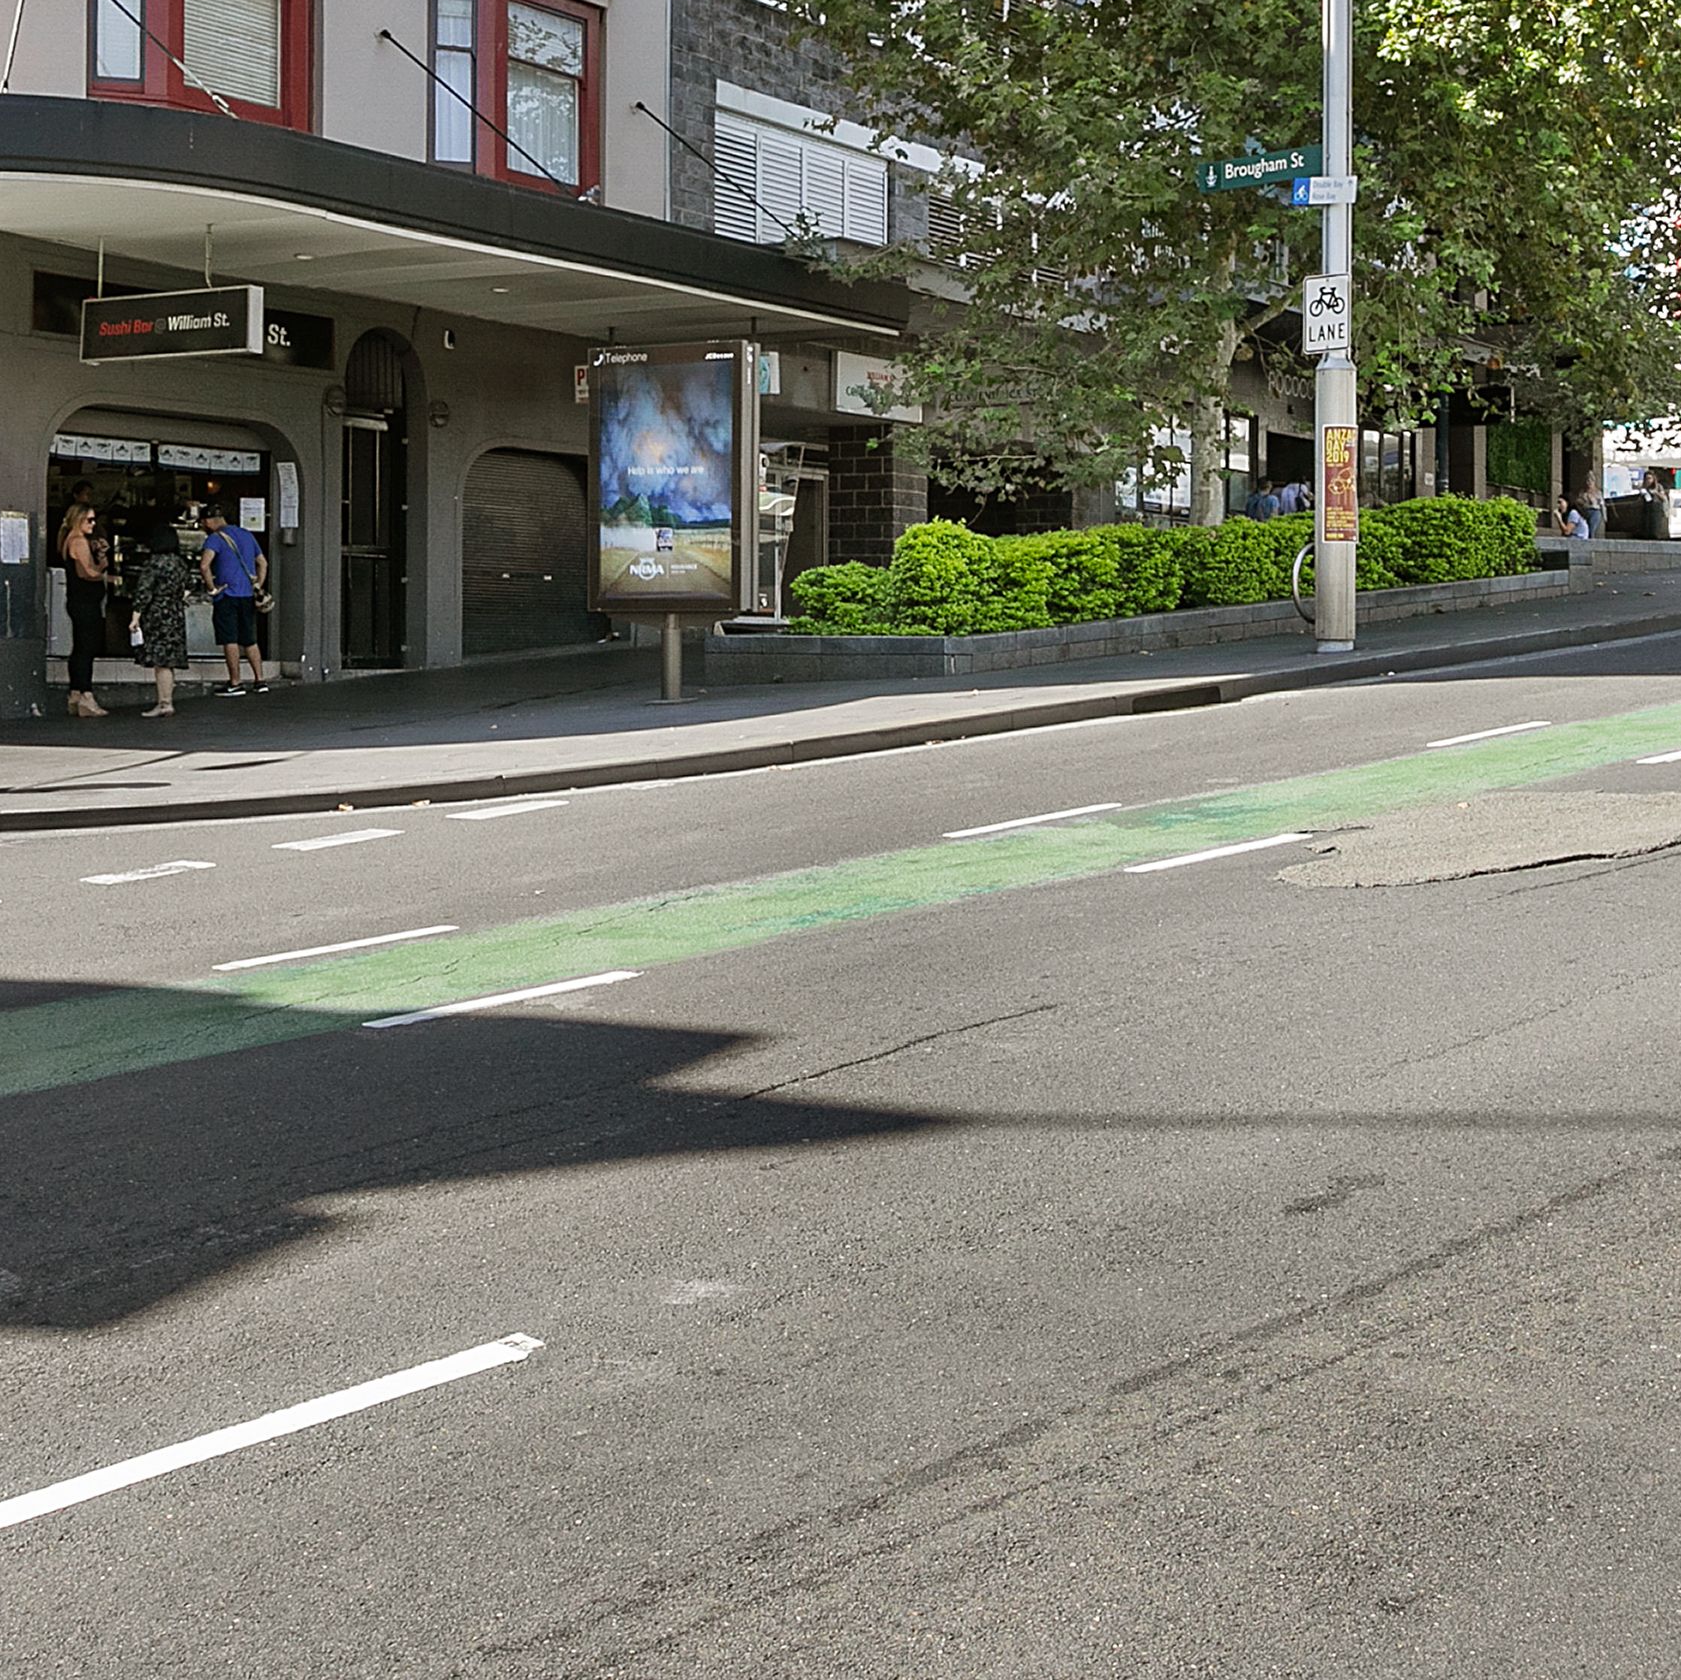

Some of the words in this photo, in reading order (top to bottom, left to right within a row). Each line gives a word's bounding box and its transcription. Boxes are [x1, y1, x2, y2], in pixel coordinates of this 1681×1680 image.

[1225, 157, 1288, 180] Brougham
[1290, 152, 1305, 168] St
[98, 321, 131, 336] Sushi
[133, 319, 154, 334] Bar
[168, 314, 212, 331] William
[213, 312, 230, 328] St.
[267, 324, 291, 346] St.
[1309, 323, 1345, 343] LANE
[605, 352, 648, 366] Telephone
[1326, 440, 1345, 451] DAY
[1326, 451, 1350, 463] 2019
[628, 465, 645, 476] Help
[647, 466, 654, 475] is
[655, 465, 675, 475] who
[676, 467, 689, 475] we
[690, 466, 704, 474] are
[630, 562, 664, 577] NRMA
